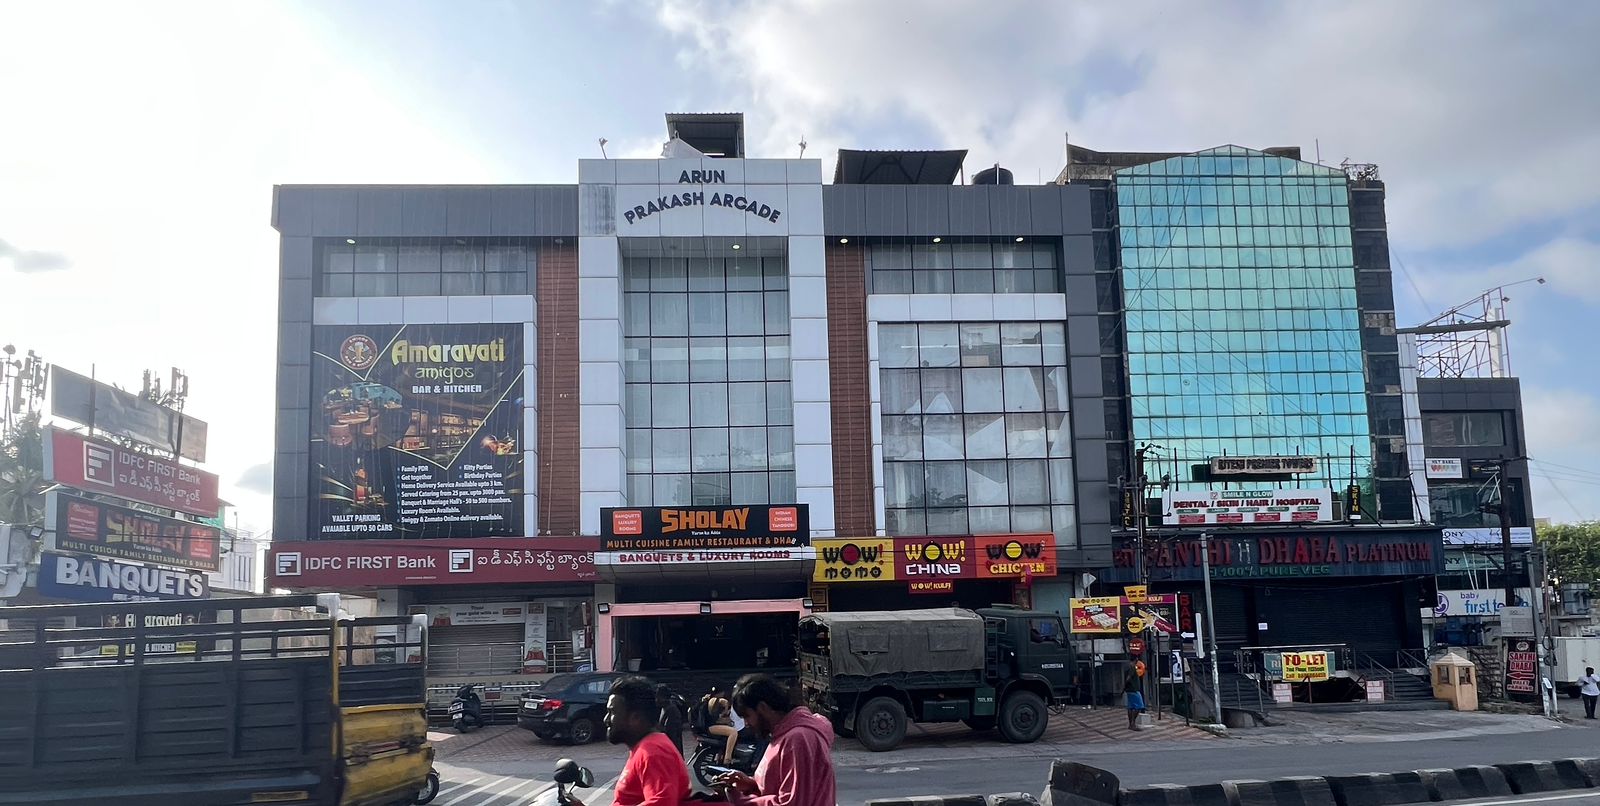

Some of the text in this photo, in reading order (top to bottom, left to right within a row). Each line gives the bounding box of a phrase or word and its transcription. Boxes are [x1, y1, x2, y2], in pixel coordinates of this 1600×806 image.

[678, 170, 725, 183] ARUN
[624, 192, 782, 224] PRAKASH ARCADE
[392, 338, 506, 365] Amaravati
[415, 367, 474, 384] amigos
[412, 385, 431, 394] BAR
[434, 385, 441, 393] &
[120, 452, 201, 485] IDFC FIRST Bank
[661, 508, 750, 533] SHOLAY
[62, 540, 87, 551] MULTI
[120, 549, 146, 559] FAMILY
[606, 540, 633, 548] MULTI
[636, 539, 670, 547] CUISINE
[673, 538, 705, 547] FAMILY
[707, 537, 762, 546] RESTAURANT
[904, 540, 966, 562] WOW!
[619, 553, 683, 563] BANQUETS
[687, 553, 695, 561] &
[750, 550, 791, 559] ROOMS
[823, 544, 884, 565] WOW!
[1346, 543, 1432, 562] PLATINUM
[305, 556, 436, 570] IDFC FIRST Bank
[56, 556, 203, 597] BANQUETS
[1181, 595, 1192, 630] BAR
[1465, 599, 1492, 613] first
[126, 613, 182, 627] Aaravati
[1283, 654, 1325, 666] TO-LET
[1510, 652, 1536, 661] SANTHI
